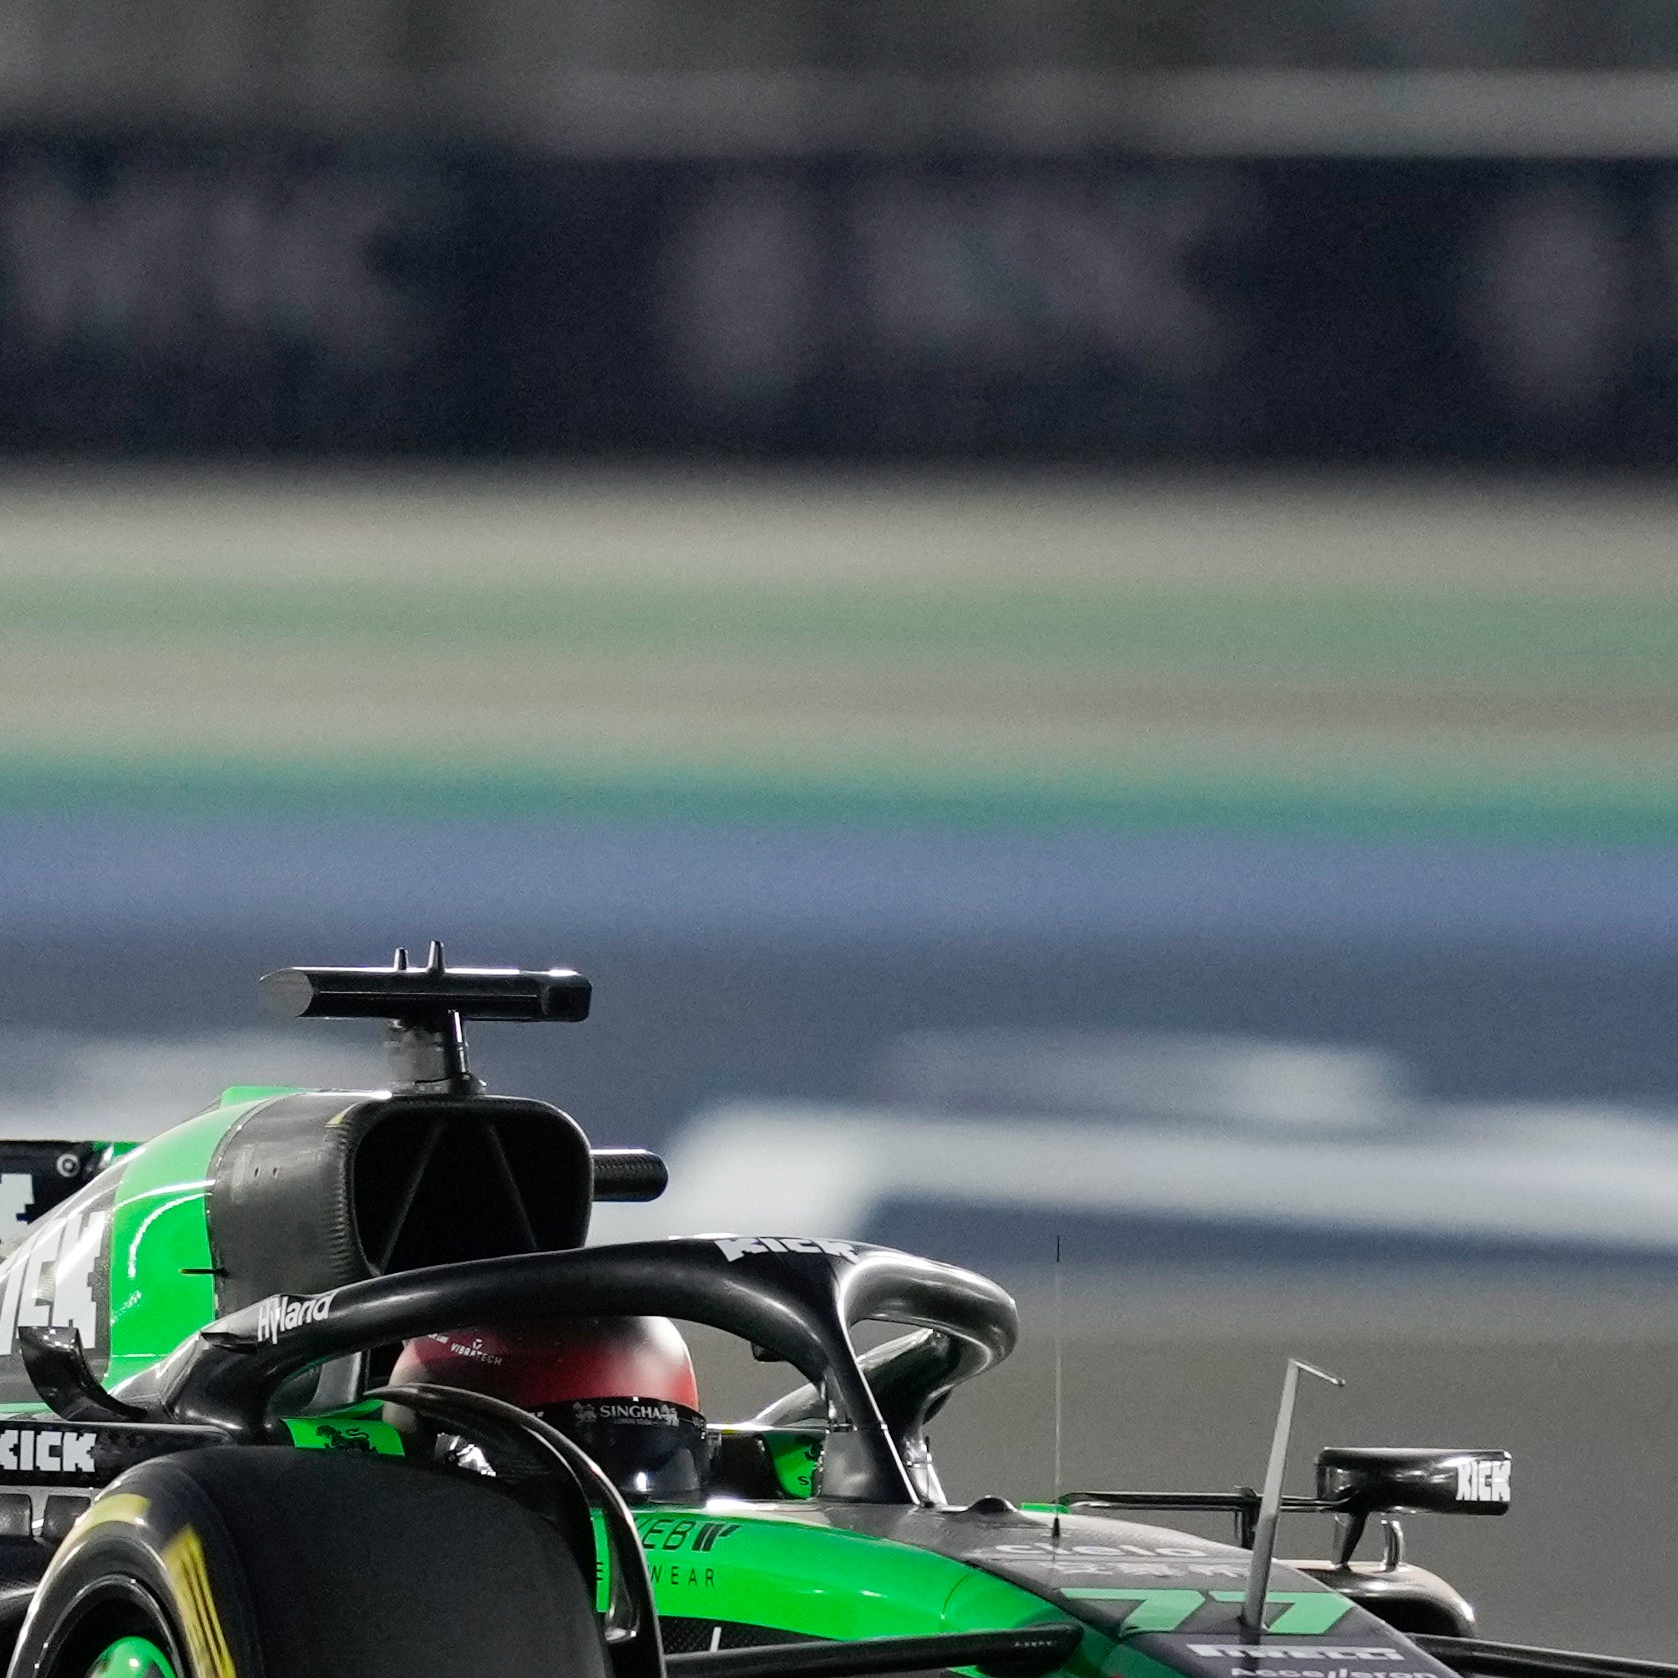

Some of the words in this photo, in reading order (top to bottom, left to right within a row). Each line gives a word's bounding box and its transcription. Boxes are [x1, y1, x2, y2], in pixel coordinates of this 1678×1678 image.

[713, 1237, 860, 1265] KICK
[257, 1291, 334, 1345] Hyland
[599, 1404, 662, 1419] SINGHA
[1455, 1460, 1512, 1502] KICK
[1059, 1586, 1355, 1635] 77
